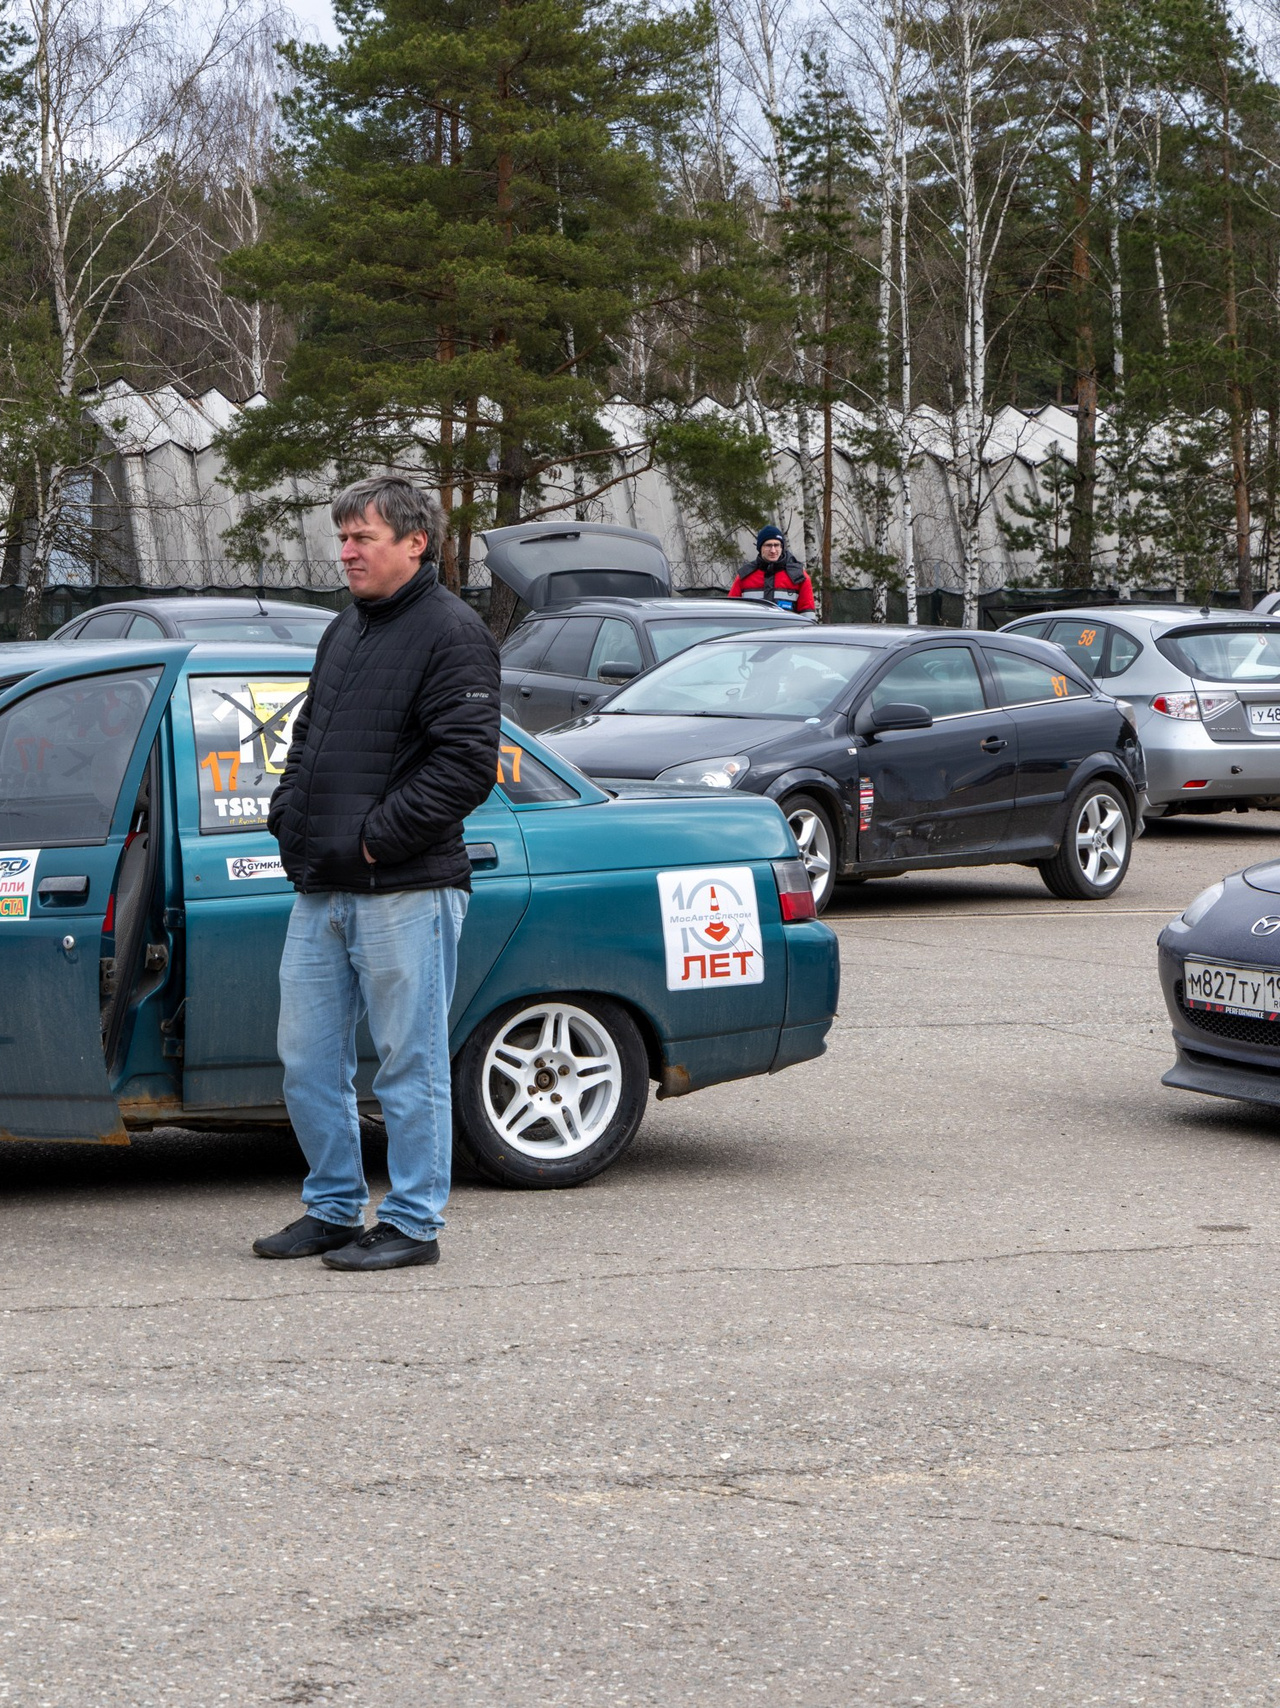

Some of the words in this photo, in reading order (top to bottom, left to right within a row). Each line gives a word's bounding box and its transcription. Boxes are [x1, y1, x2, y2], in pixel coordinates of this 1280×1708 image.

[1078, 629, 1097, 647] 58
[1050, 675, 1069, 697] 87
[201, 751, 241, 792] 17
[681, 950, 754, 981] ЛЕТ
[1225, 1006, 1265, 1019] PERFORMANCE
